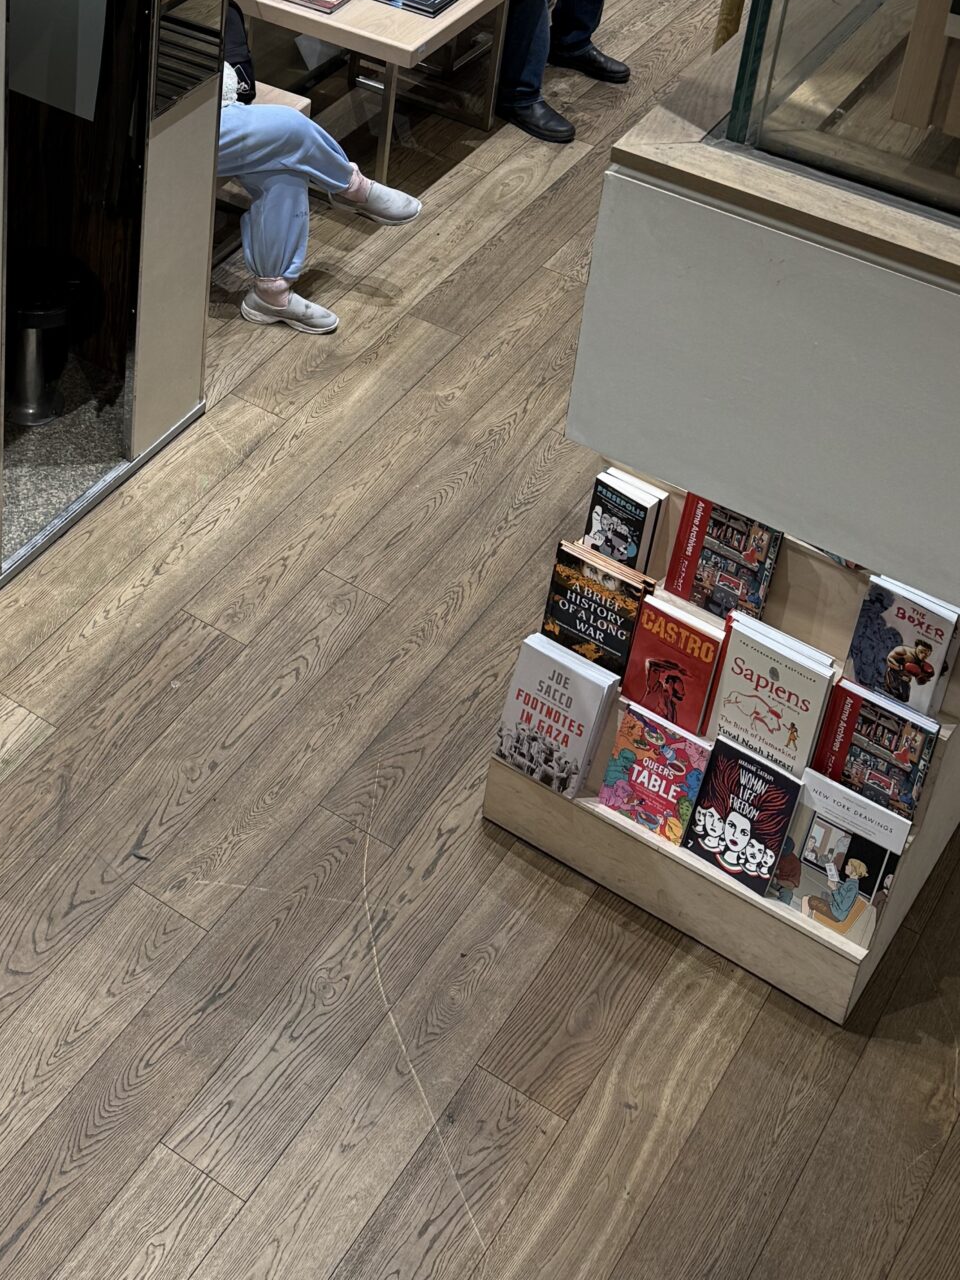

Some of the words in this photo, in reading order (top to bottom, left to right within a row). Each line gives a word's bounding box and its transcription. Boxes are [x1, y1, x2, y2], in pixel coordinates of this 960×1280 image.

[597, 485, 646, 518] PERSEPOLIS
[693, 500, 706, 522] Anime
[686, 520, 700, 557] Archives
[566, 590, 624, 626] HISTORY
[572, 582, 581, 592] A
[584, 587, 621, 612] BRIEF
[910, 606, 927, 620] THE
[559, 600, 577, 613] OF
[578, 610, 587, 620] A
[589, 614, 627, 640] LONG
[576, 619, 605, 643] WAR
[642, 608, 716, 664] CASTRO
[894, 606, 945, 642] BOXER
[537, 680, 574, 710] SACCO
[548, 669, 571, 691] JOE
[731, 656, 812, 713] Sapiens
[515, 688, 585, 738] FOOTNOTES
[841, 695, 855, 718] Anime
[519, 708, 534, 726] IN
[536, 717, 571, 749] GAZA
[720, 714, 732, 726] The
[733, 721, 749, 734] Birth
[833, 715, 847, 752] Archives
[718, 723, 740, 744] Yuval
[741, 738, 765, 756] Noah
[766, 751, 794, 773] Harari
[631, 763, 682, 805] TABLE
[642, 757, 675, 781] QUEERS
[739, 768, 768, 796] WOMAN
[729, 794, 760, 821] FREEDOM
[739, 785, 758, 805] LIFE
[812, 787, 829, 800] NEW
[832, 799, 851, 812] YORK
[853, 809, 894, 835] DRAWINGS
